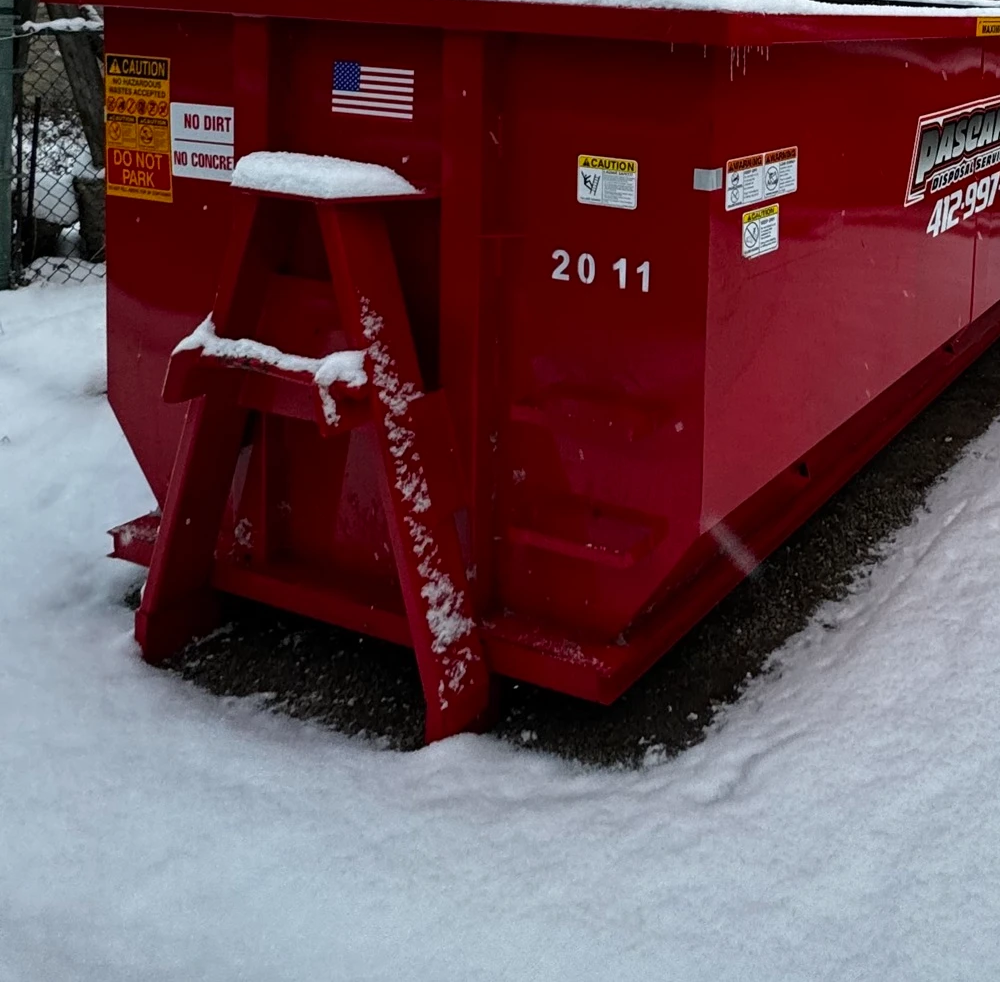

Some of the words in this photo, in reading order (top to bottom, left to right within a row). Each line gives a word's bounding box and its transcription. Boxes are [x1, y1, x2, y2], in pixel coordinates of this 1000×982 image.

[122, 58, 166, 77] CAUTION
[112, 77, 122, 85] NO
[123, 78, 162, 89] HAZARDOUS
[109, 86, 132, 95] WASTES
[133, 88, 166, 98] ACCEPTED
[184, 113, 200, 129] NO
[204, 115, 231, 132] DIRT
[113, 149, 133, 167] DO
[136, 152, 162, 170] NOT
[174, 150, 188, 166] NO
[591, 158, 635, 172] CAUTION
[122, 169, 155, 188] PARK
[931, 159, 973, 191] DISPOSAL
[751, 206, 775, 219] CAUTION
